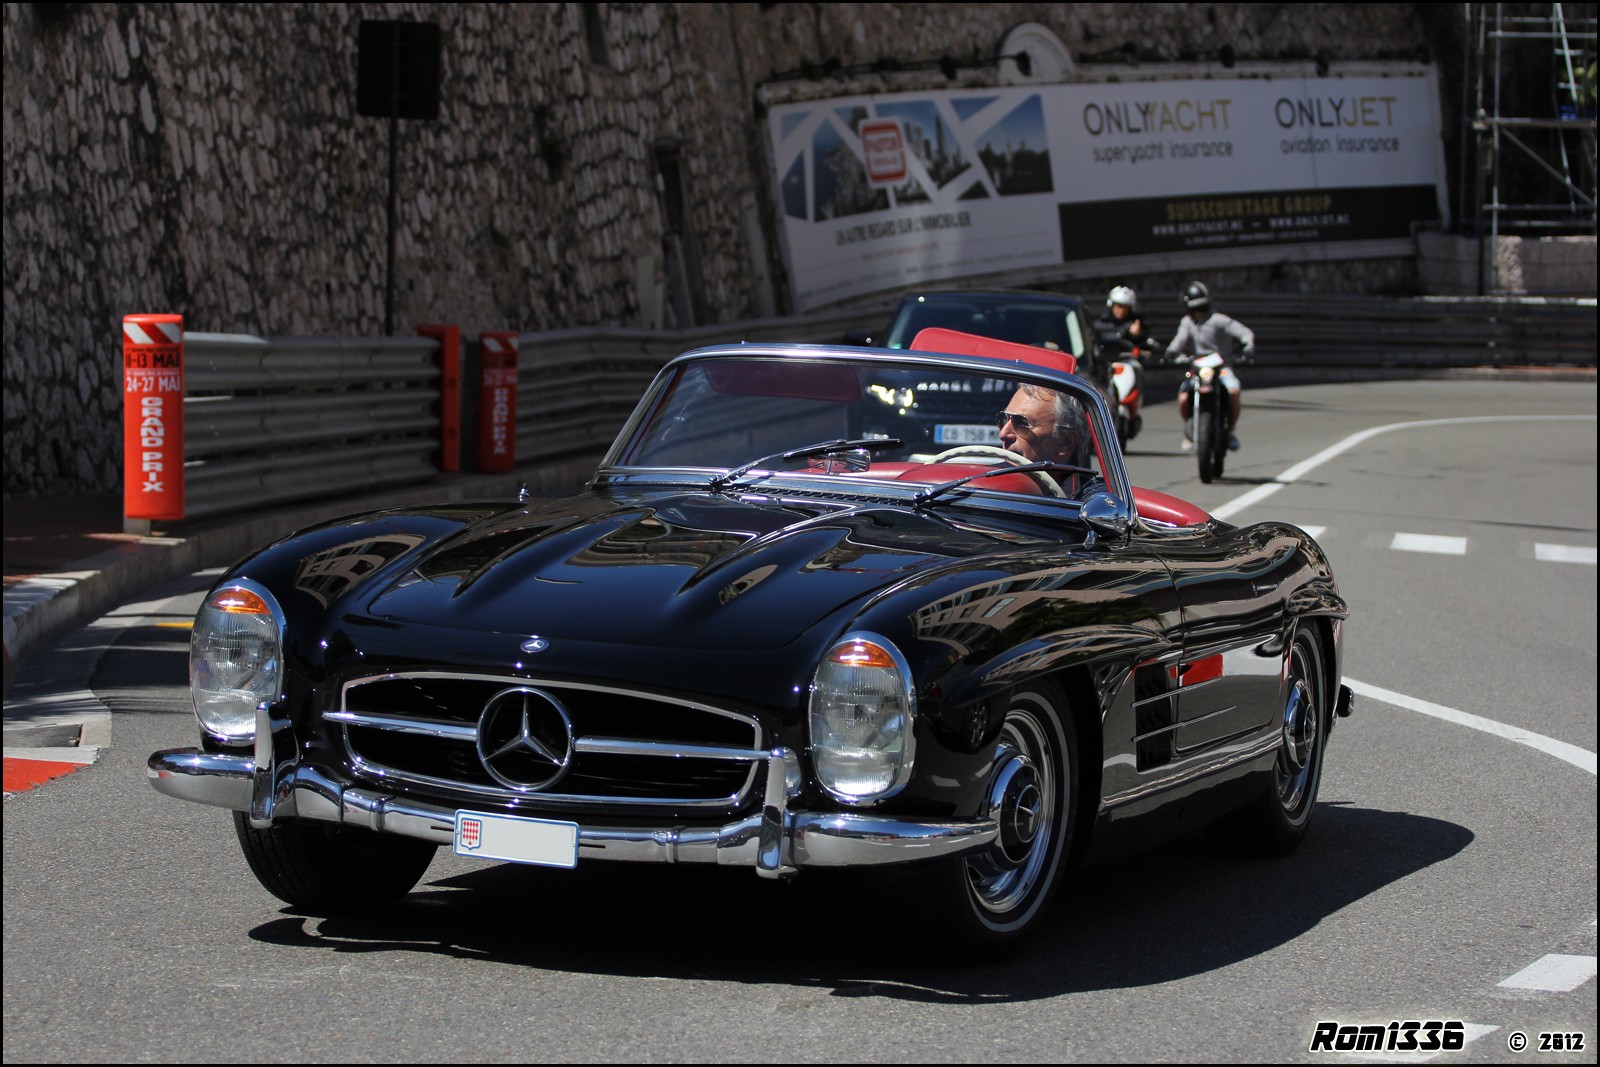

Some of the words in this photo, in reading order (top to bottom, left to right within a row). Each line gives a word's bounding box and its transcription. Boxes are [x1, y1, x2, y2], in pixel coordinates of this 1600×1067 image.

[1082, 99, 1233, 137] ONLYYACHT
[1275, 96, 1398, 130] ONLYJET
[1092, 142, 1165, 166] superyacht
[1169, 140, 1234, 160] insurance
[1279, 135, 1332, 154] aviation
[1336, 134, 1401, 153] insurance
[1283, 194, 1333, 213] GROUP
[153, 352, 180, 368] MAI
[126, 376, 155, 392] 24-27
[158, 375, 181, 391] MAI
[140, 397, 165, 448] GRAND
[142, 451, 164, 493] PRIX
